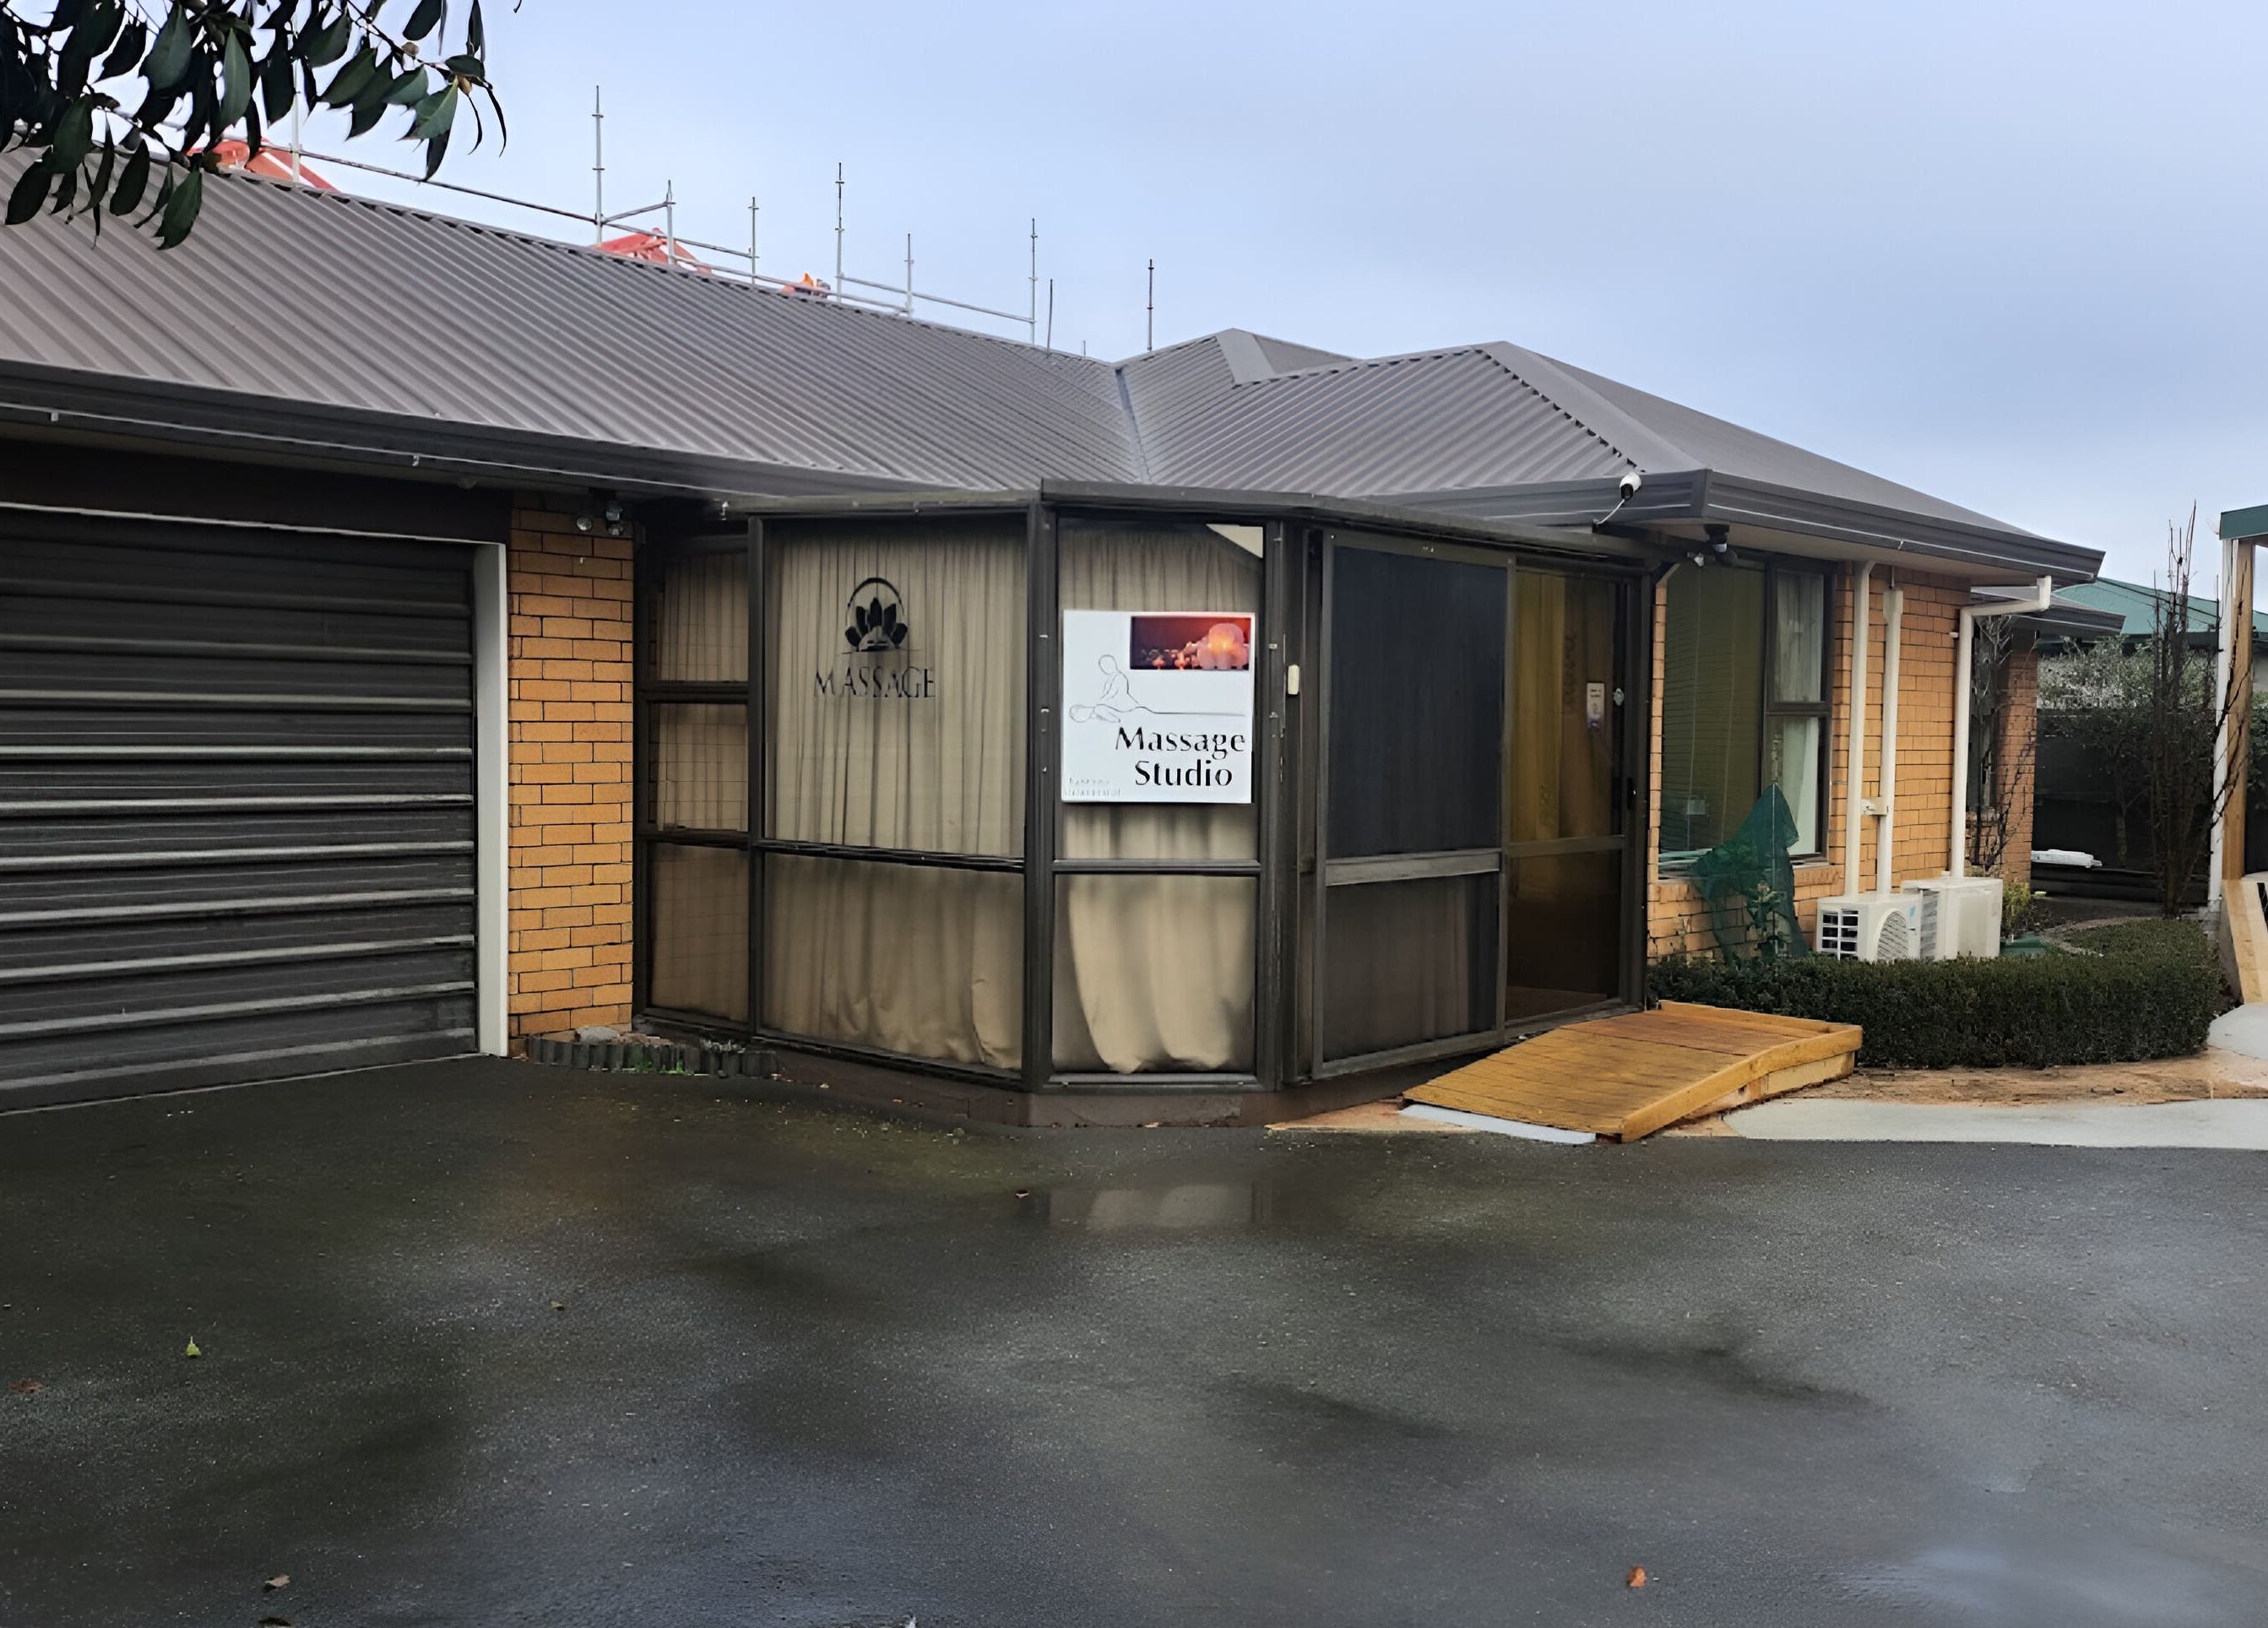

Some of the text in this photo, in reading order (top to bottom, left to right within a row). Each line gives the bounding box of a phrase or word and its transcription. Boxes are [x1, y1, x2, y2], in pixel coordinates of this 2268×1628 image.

[815, 665, 936, 697] MASSAGE
[1116, 727, 1245, 759] Massage
[1136, 759, 1232, 786] Studio
